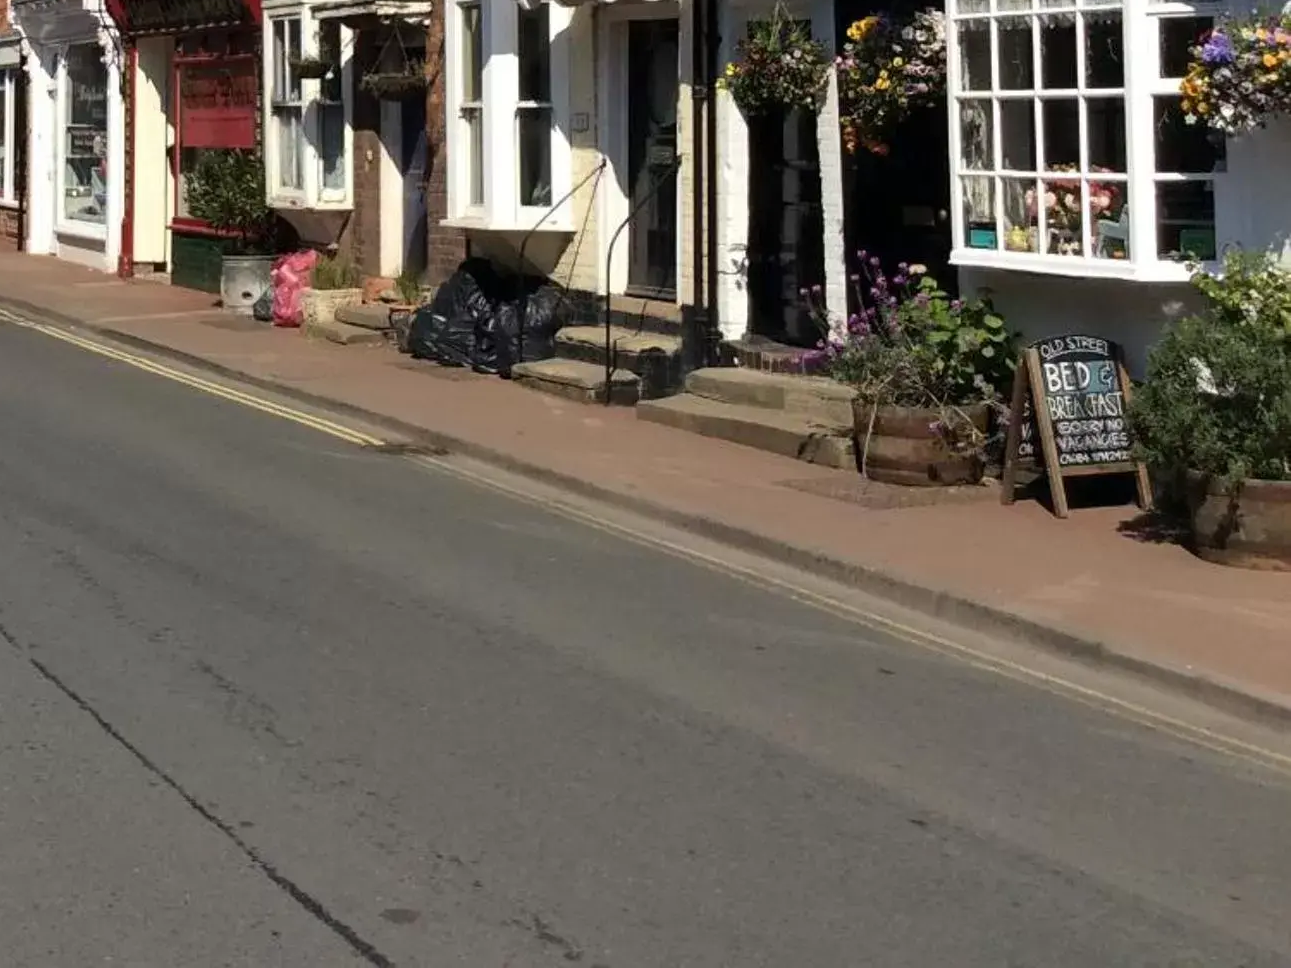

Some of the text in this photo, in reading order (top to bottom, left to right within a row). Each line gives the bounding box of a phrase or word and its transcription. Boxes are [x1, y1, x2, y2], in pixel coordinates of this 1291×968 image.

[1041, 336, 1109, 359] OLD STREET
[1043, 361, 1090, 392] BED
[1105, 418, 1124, 432] NO
